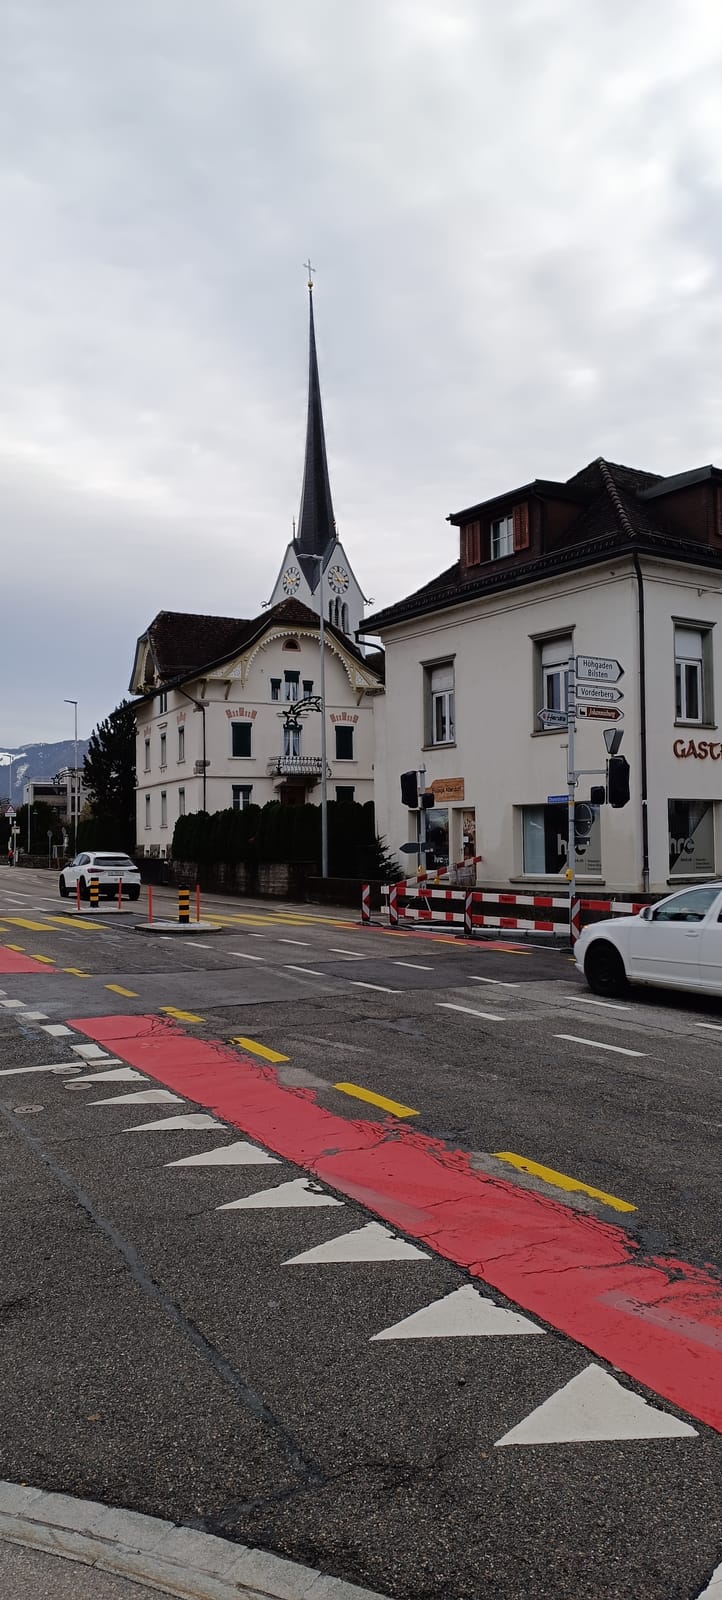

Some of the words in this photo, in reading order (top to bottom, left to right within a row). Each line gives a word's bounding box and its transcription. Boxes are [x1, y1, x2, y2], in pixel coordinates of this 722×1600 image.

[583, 659, 613, 670] Höhgaden
[588, 669, 608, 678] Bilsten
[581, 687, 614, 699] Vorderberg
[673, 739, 722, 760] GAST
